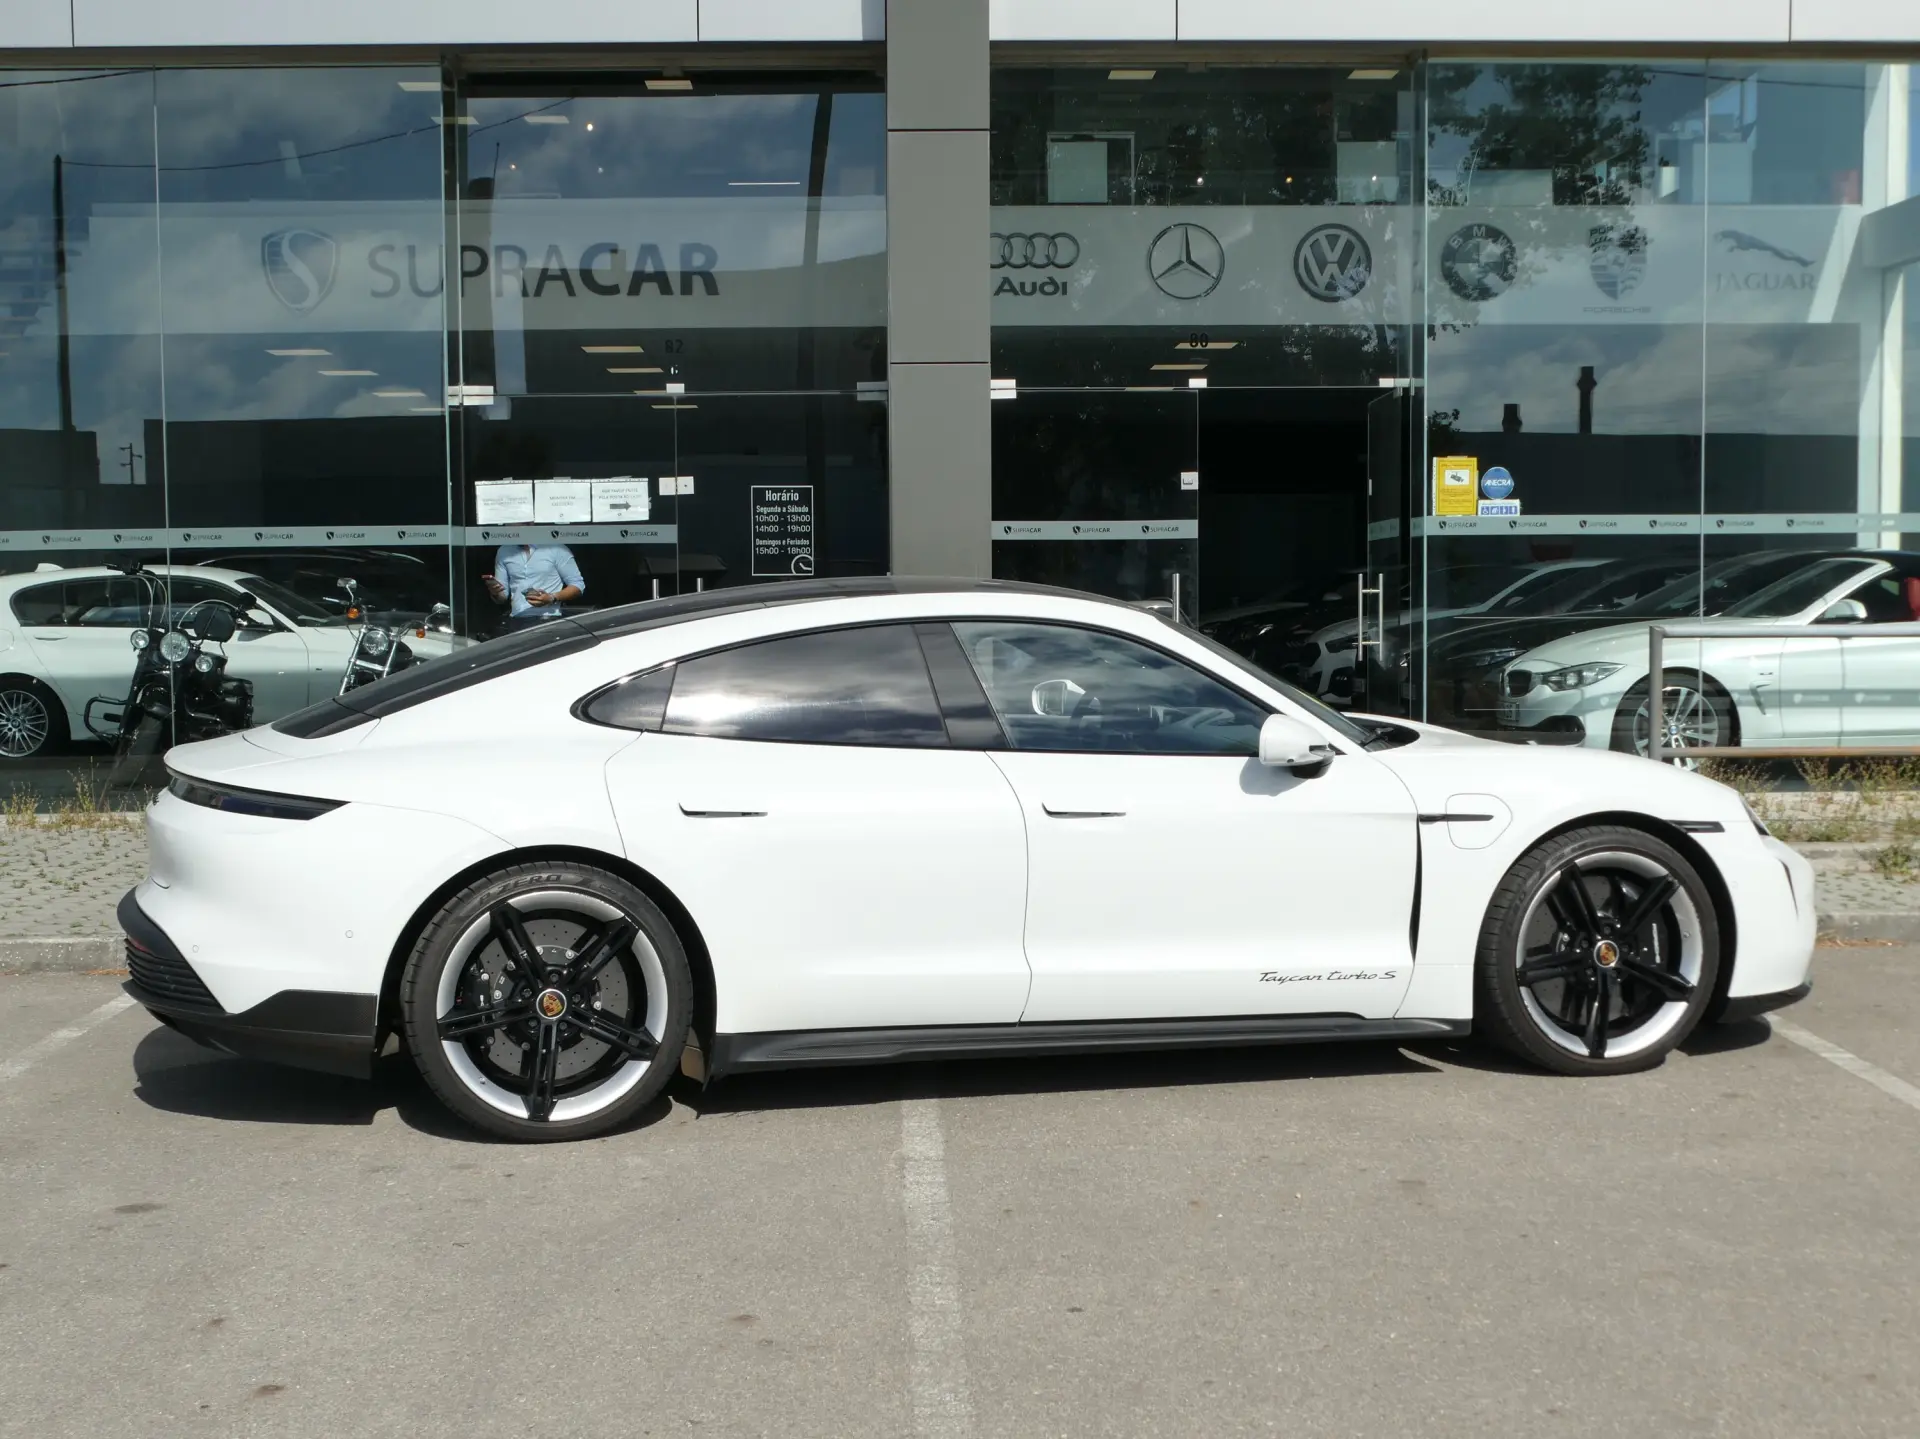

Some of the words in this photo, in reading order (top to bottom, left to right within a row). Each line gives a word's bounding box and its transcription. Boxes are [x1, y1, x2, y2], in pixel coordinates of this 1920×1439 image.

[367, 242, 721, 298] SUPRACAR
[993, 276, 1068, 298] Audi
[1715, 271, 1816, 294] JAGUAR
[665, 339, 684, 354] 82
[1190, 332, 1209, 348] 80
[1484, 479, 1511, 487] ANECRA
[765, 489, 799, 501] Horário
[756, 505, 781, 514] Segunda
[787, 504, 809, 513] Sábado
[755, 514, 779, 522] 10h00
[787, 514, 811, 522] 13h00
[755, 538, 781, 547] Domingos
[1258, 971, 1323, 986] Taycan
[1378, 970, 1398, 981] S
